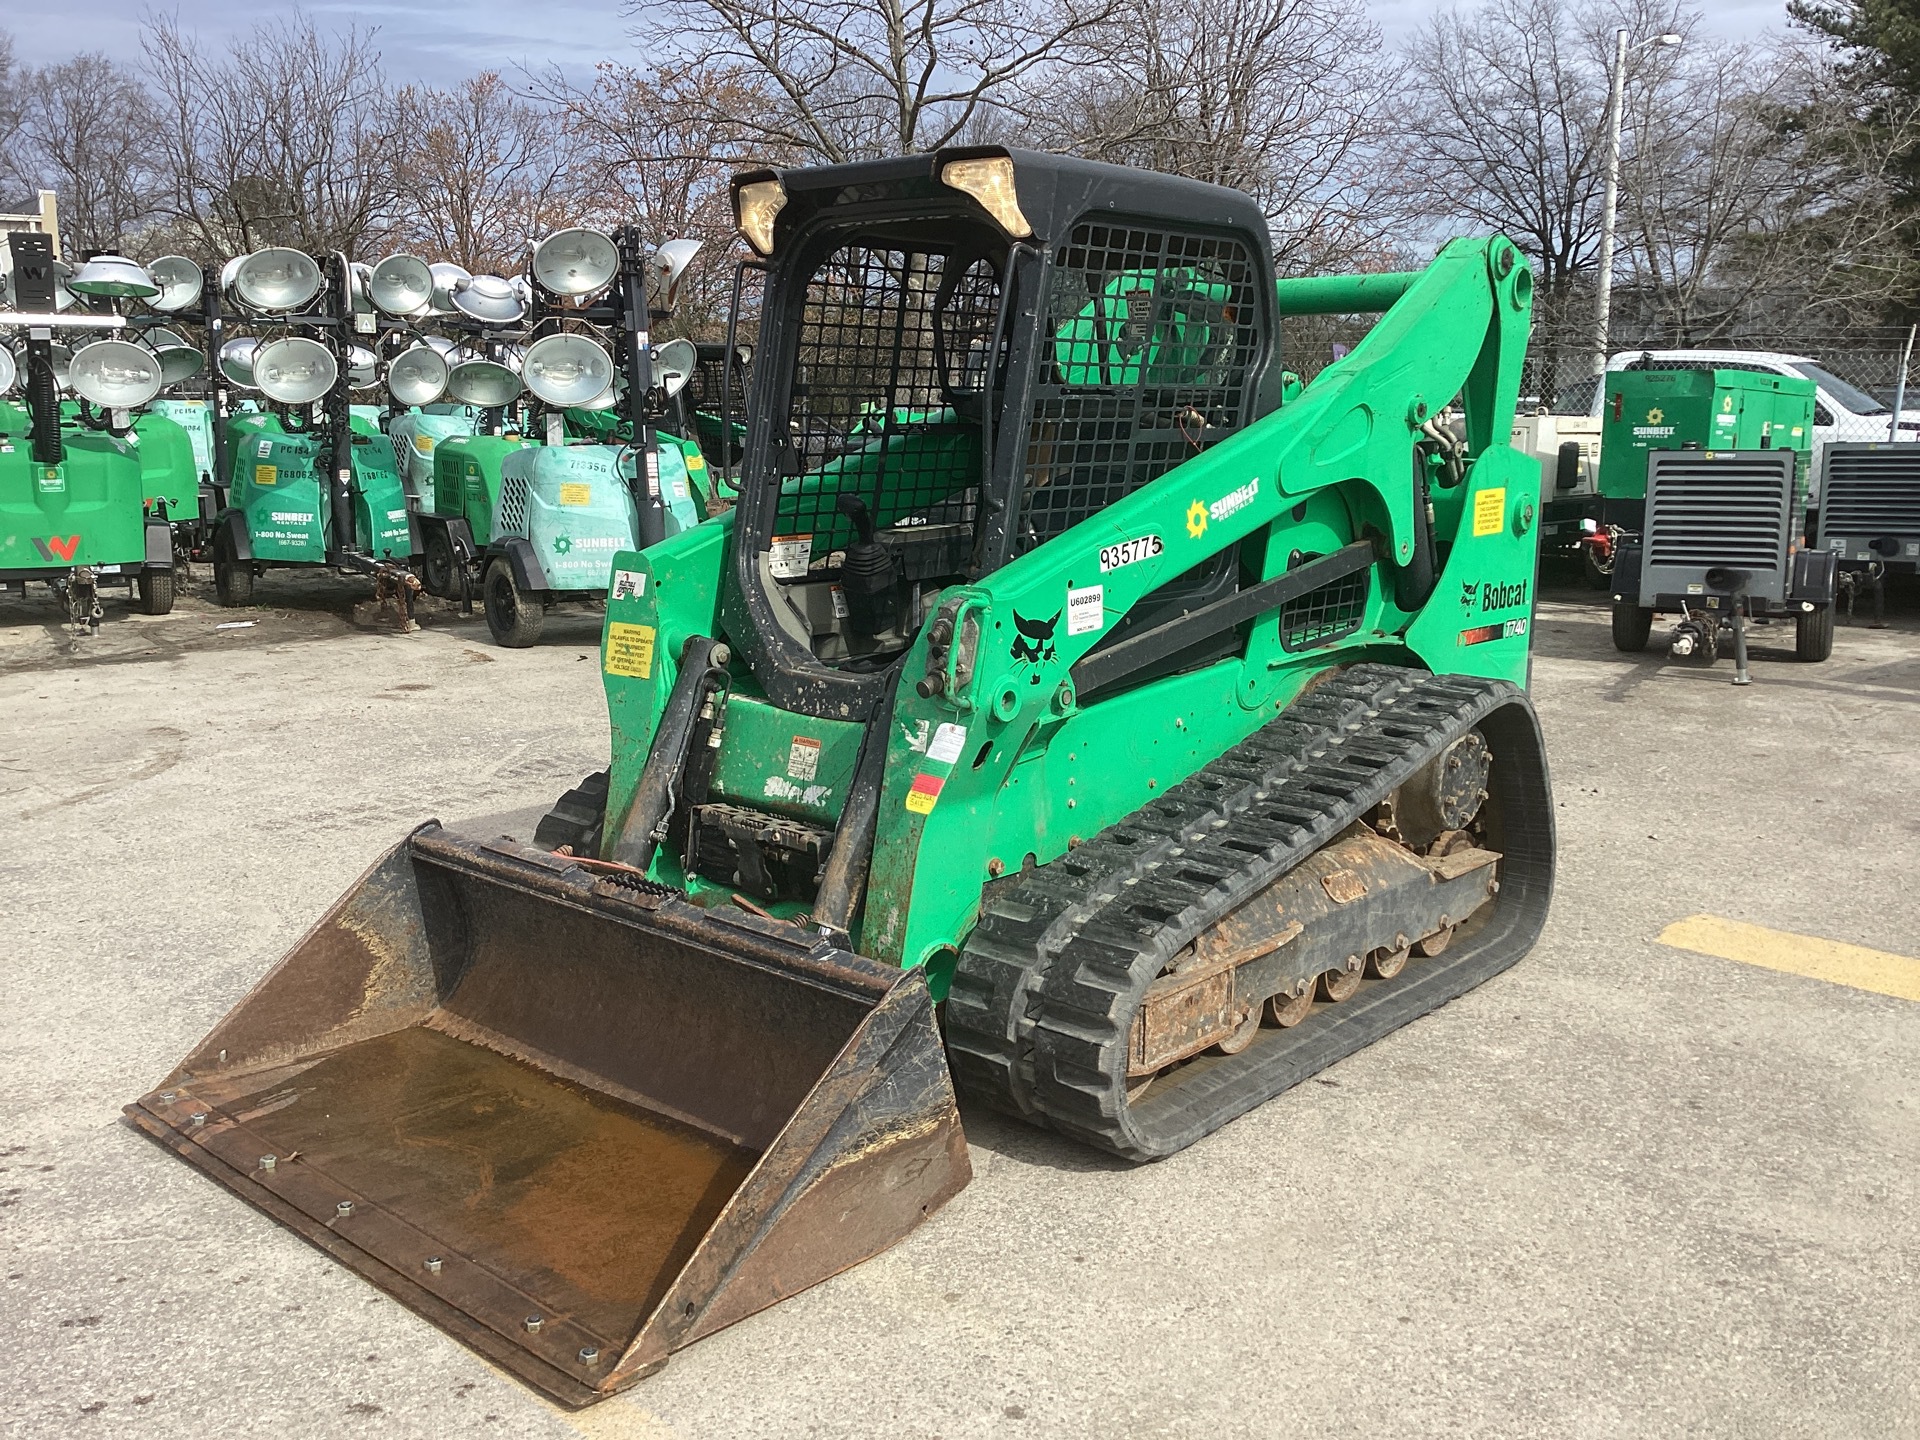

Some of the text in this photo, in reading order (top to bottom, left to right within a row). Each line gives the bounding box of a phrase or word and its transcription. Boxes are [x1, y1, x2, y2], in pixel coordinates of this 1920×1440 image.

[1632, 426, 1675, 435] SUNBELT
[280, 445, 292, 454] PC
[294, 445, 310, 455] 154
[278, 469, 313, 479] 768062
[1209, 476, 1260, 520] SUNBELT
[1218, 496, 1255, 523] RENTALS
[271, 512, 315, 522] SUNBELT
[255, 531, 309, 540] 1-800 No Sweat
[575, 537, 626, 549] SUNBELT
[1100, 535, 1163, 570] 935775
[555, 561, 579, 569] 1-800
[1070, 593, 1101, 607] U602899
[1482, 578, 1527, 613] Bobcat
[1505, 616, 1528, 639] T740
